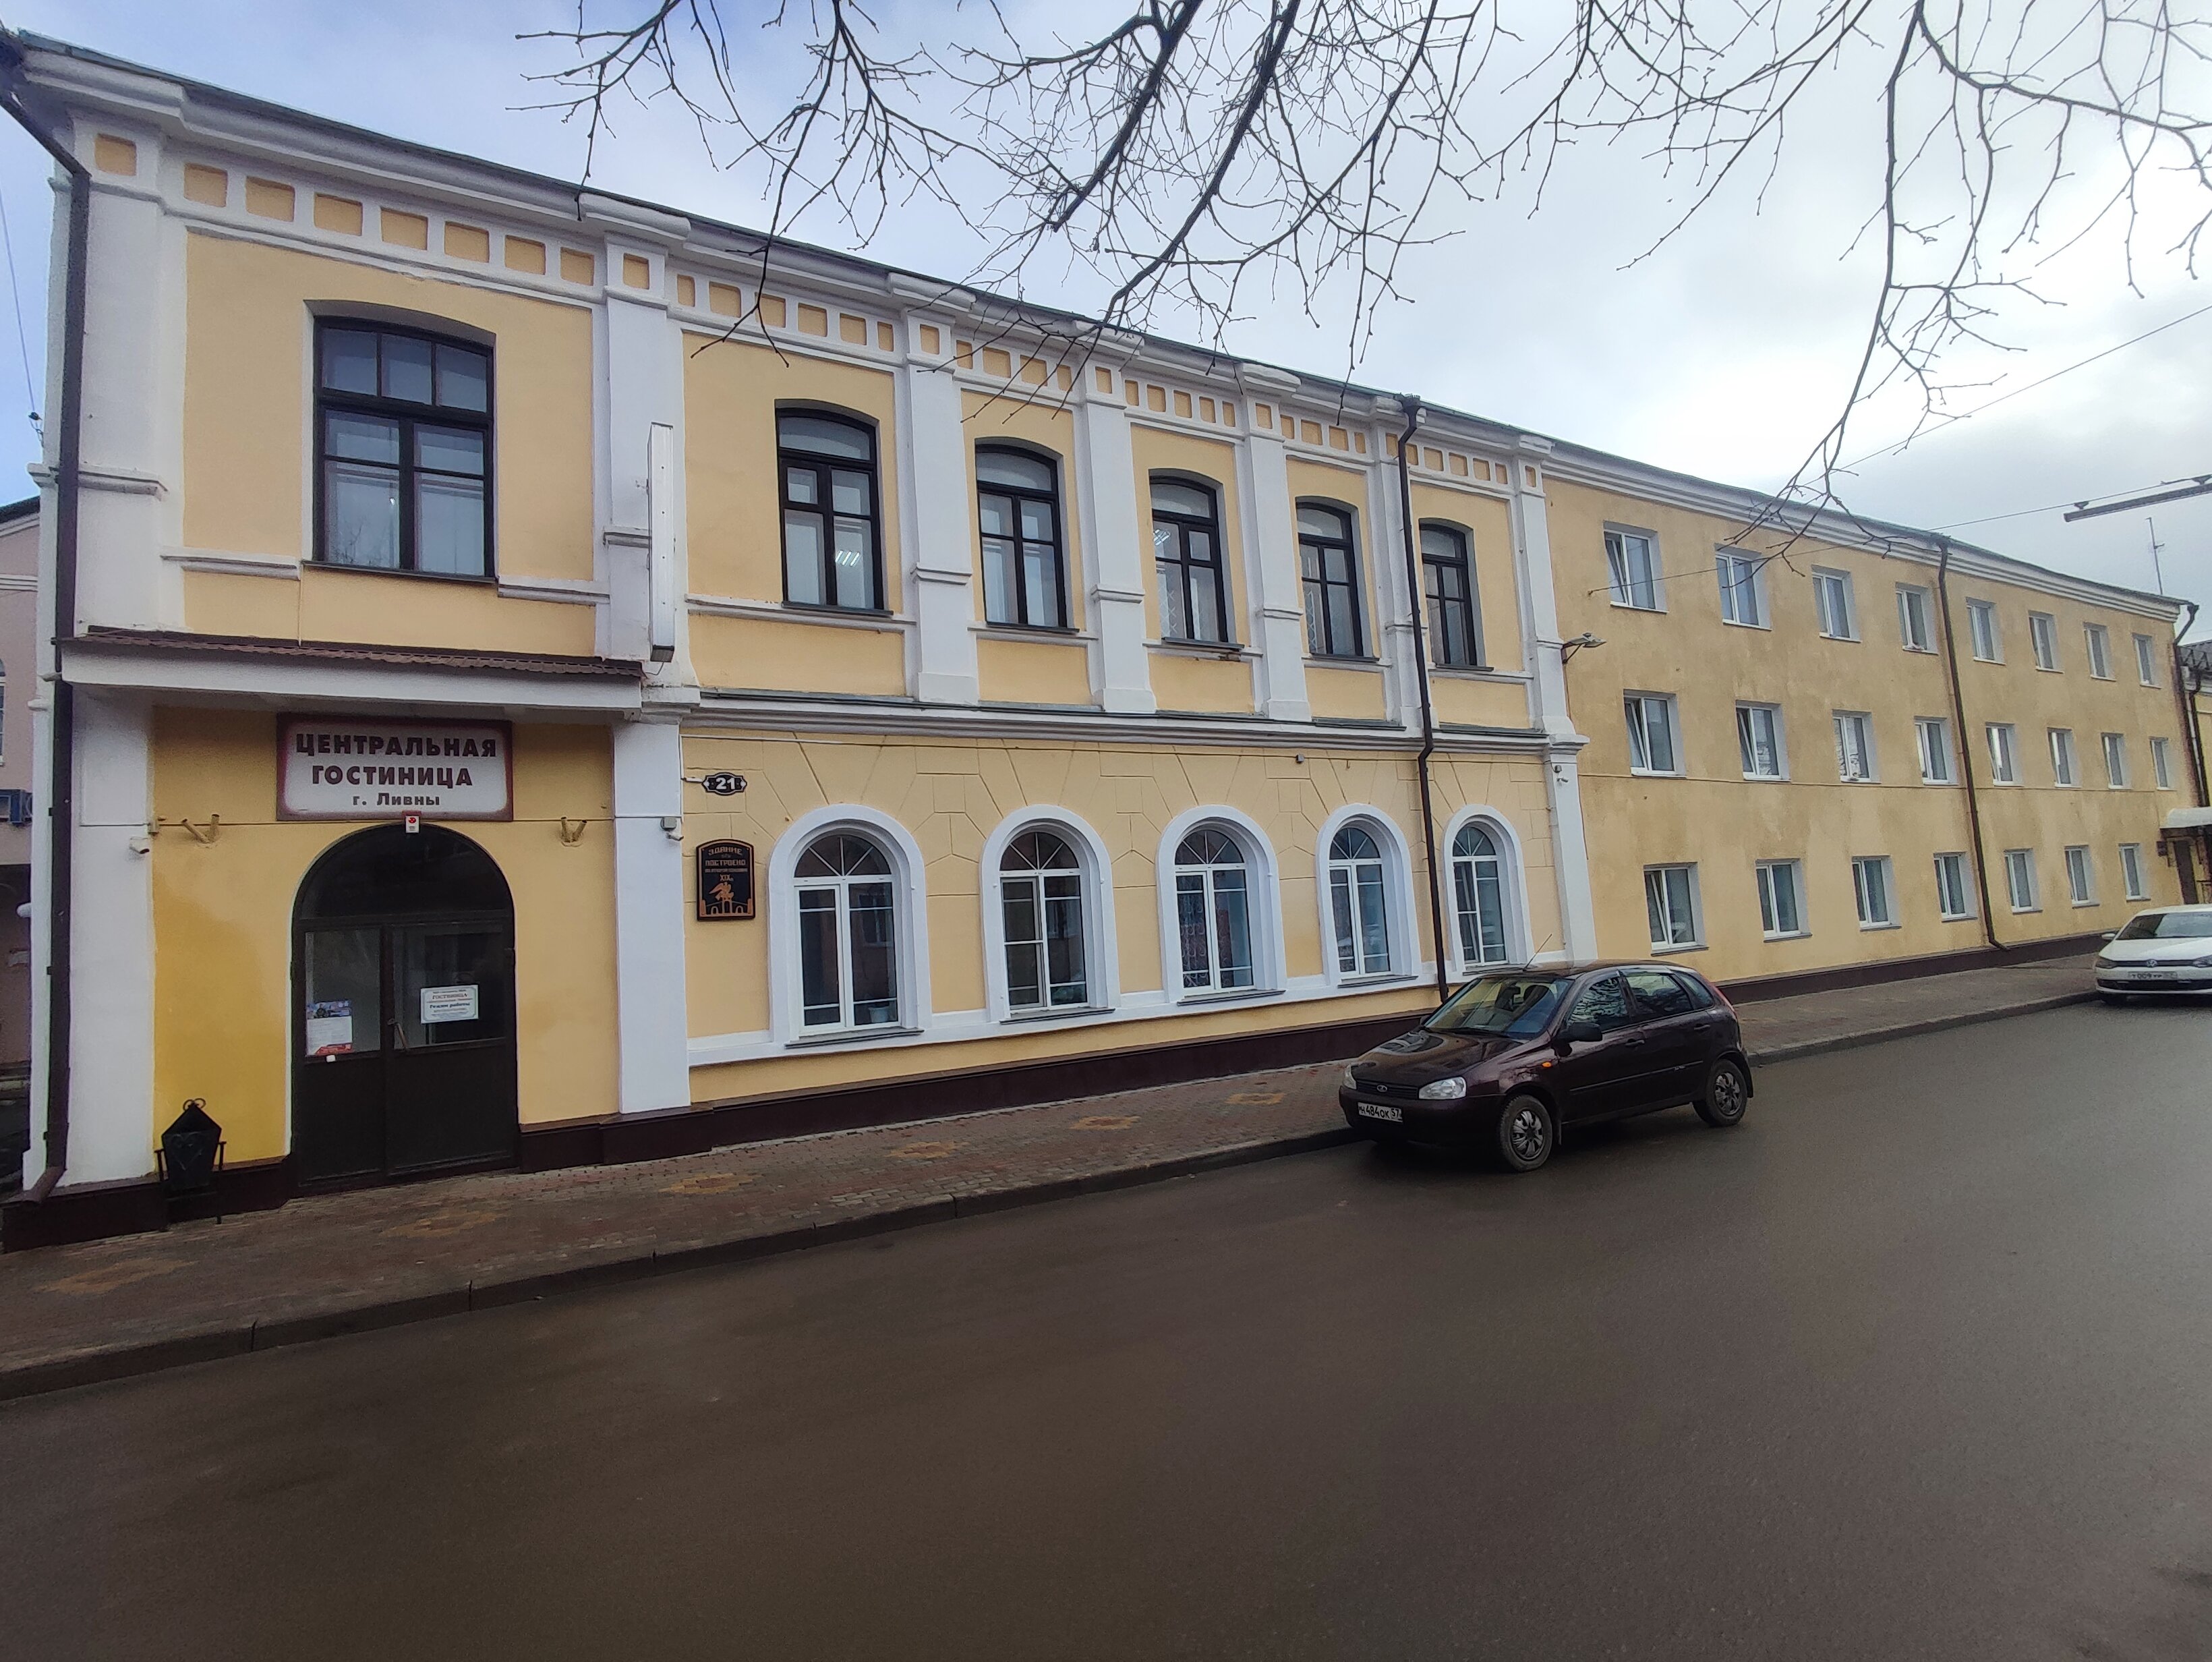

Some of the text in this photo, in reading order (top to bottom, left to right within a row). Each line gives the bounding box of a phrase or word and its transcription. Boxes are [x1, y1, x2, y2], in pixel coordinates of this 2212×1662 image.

[295, 733, 496, 757] ЦЕНТРАЛЬНАЯ
[312, 765, 473, 789] ГОСТИНИЦА
[715, 777, 736, 791] 21
[352, 792, 440, 806] г. Ливны
[705, 859, 747, 867] ПОСТРОЕНО
